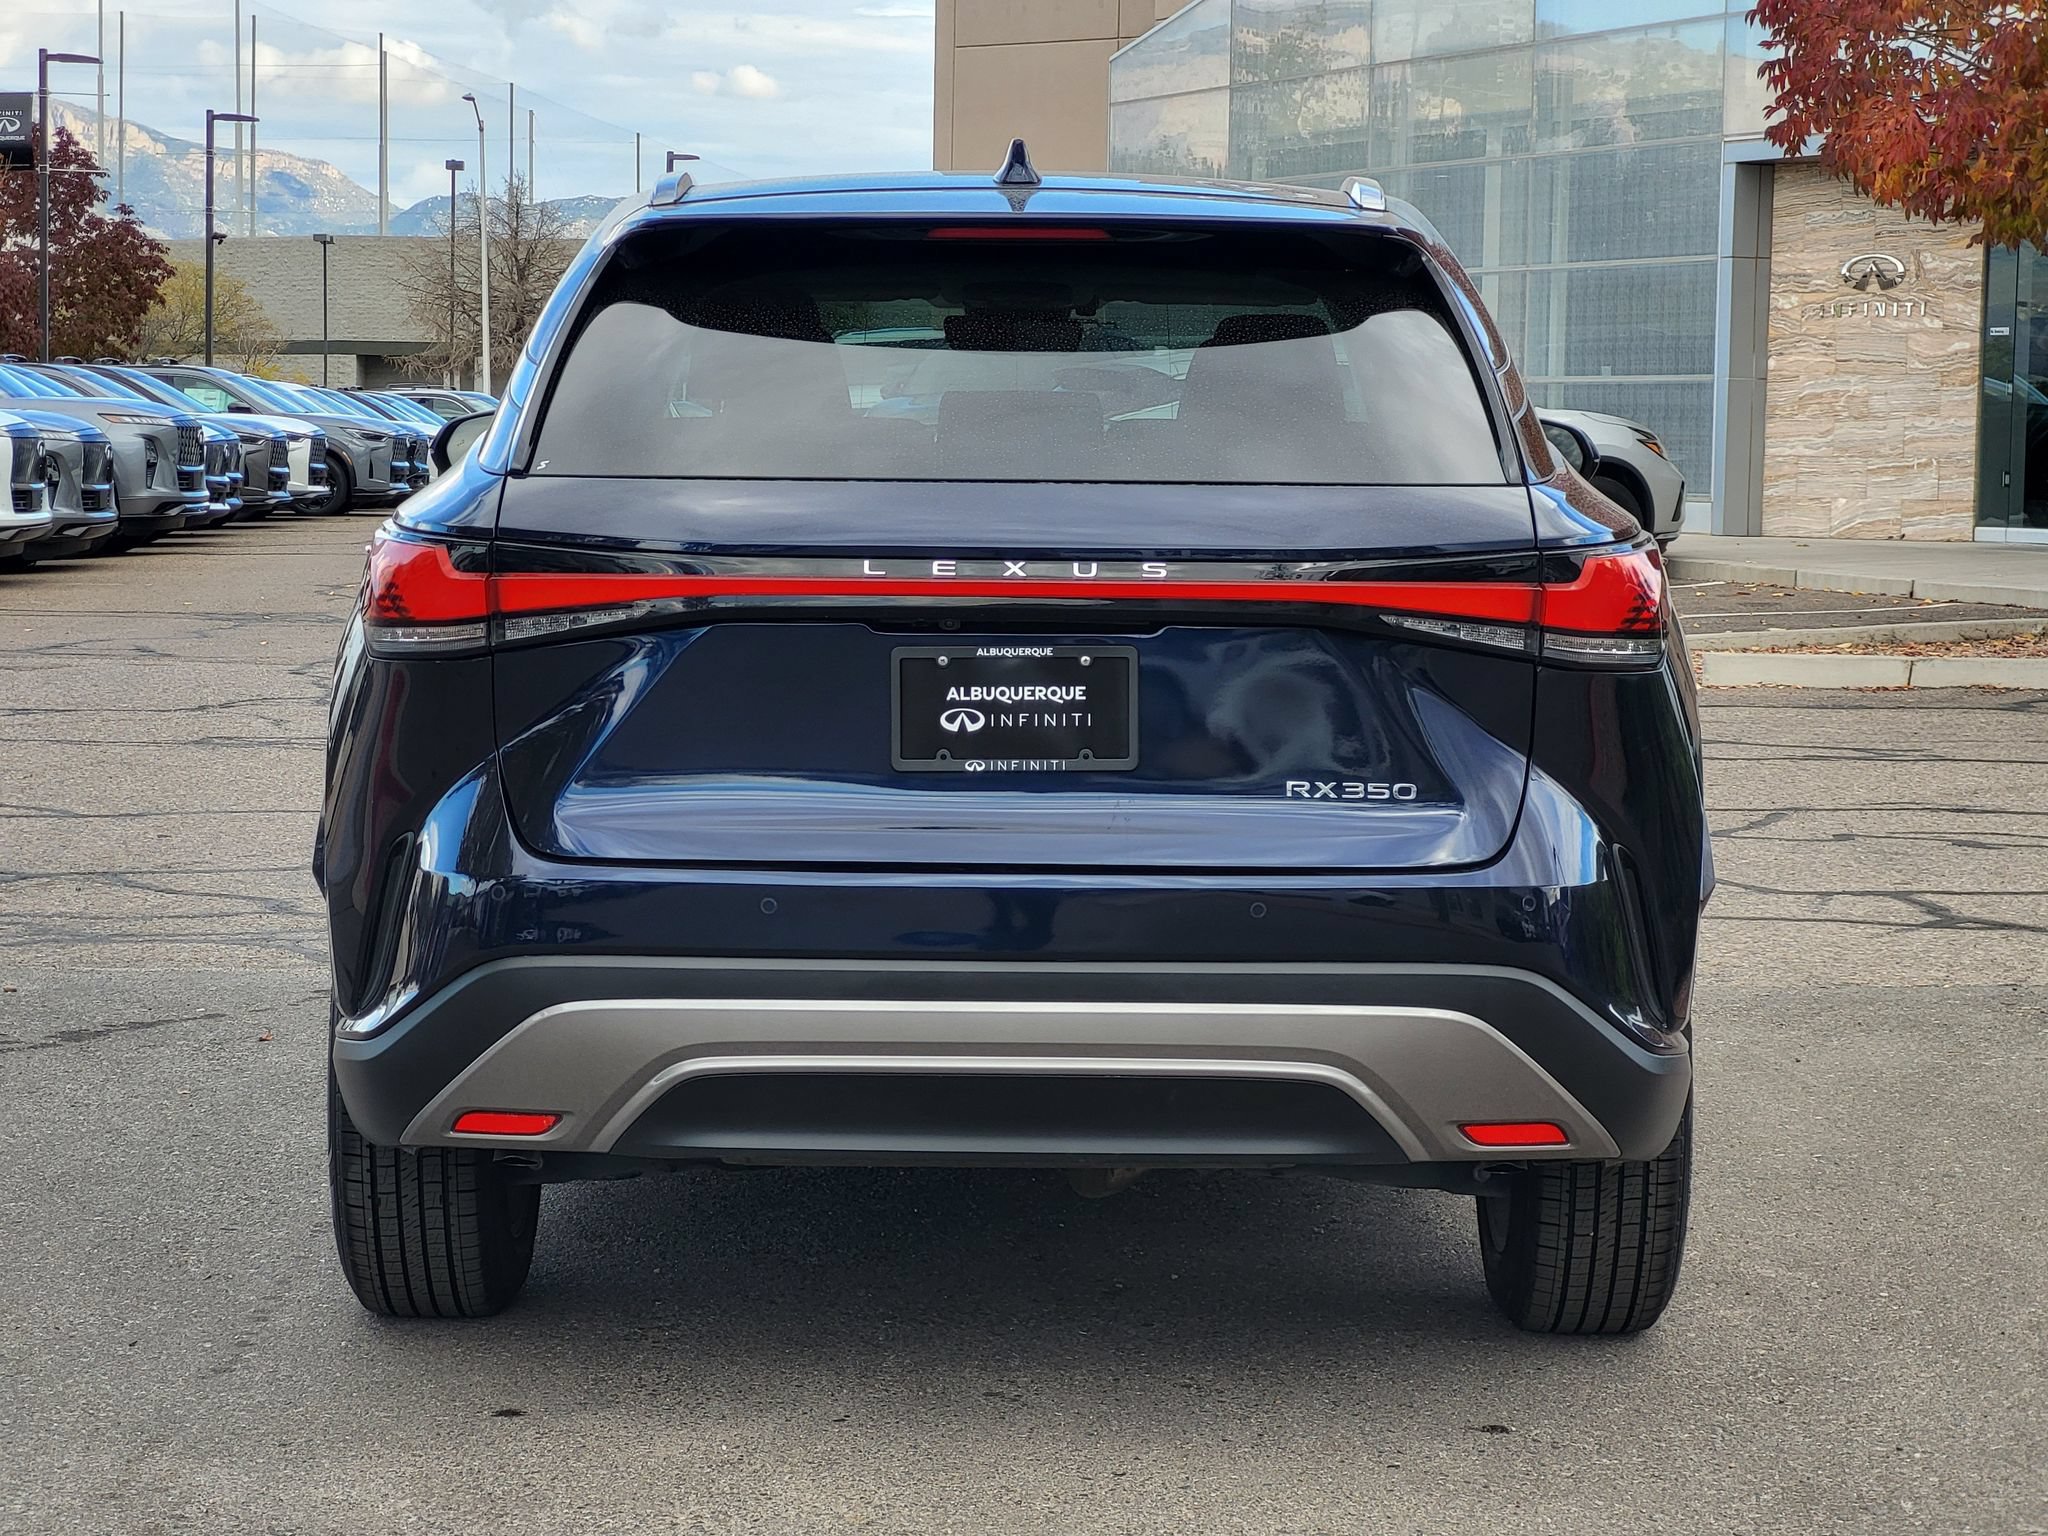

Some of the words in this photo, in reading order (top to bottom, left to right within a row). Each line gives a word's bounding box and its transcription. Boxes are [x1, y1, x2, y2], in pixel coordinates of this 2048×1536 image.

[1820, 302, 1926, 317] INFINITI
[863, 560, 1168, 578] LEXUS
[976, 647, 1053, 657] ALBUQUERQUE
[946, 686, 1087, 704] ALBUQUERQUE
[990, 713, 1092, 727] INFINITI
[990, 760, 1066, 771] INFINITI
[1286, 781, 1417, 800] RX350
